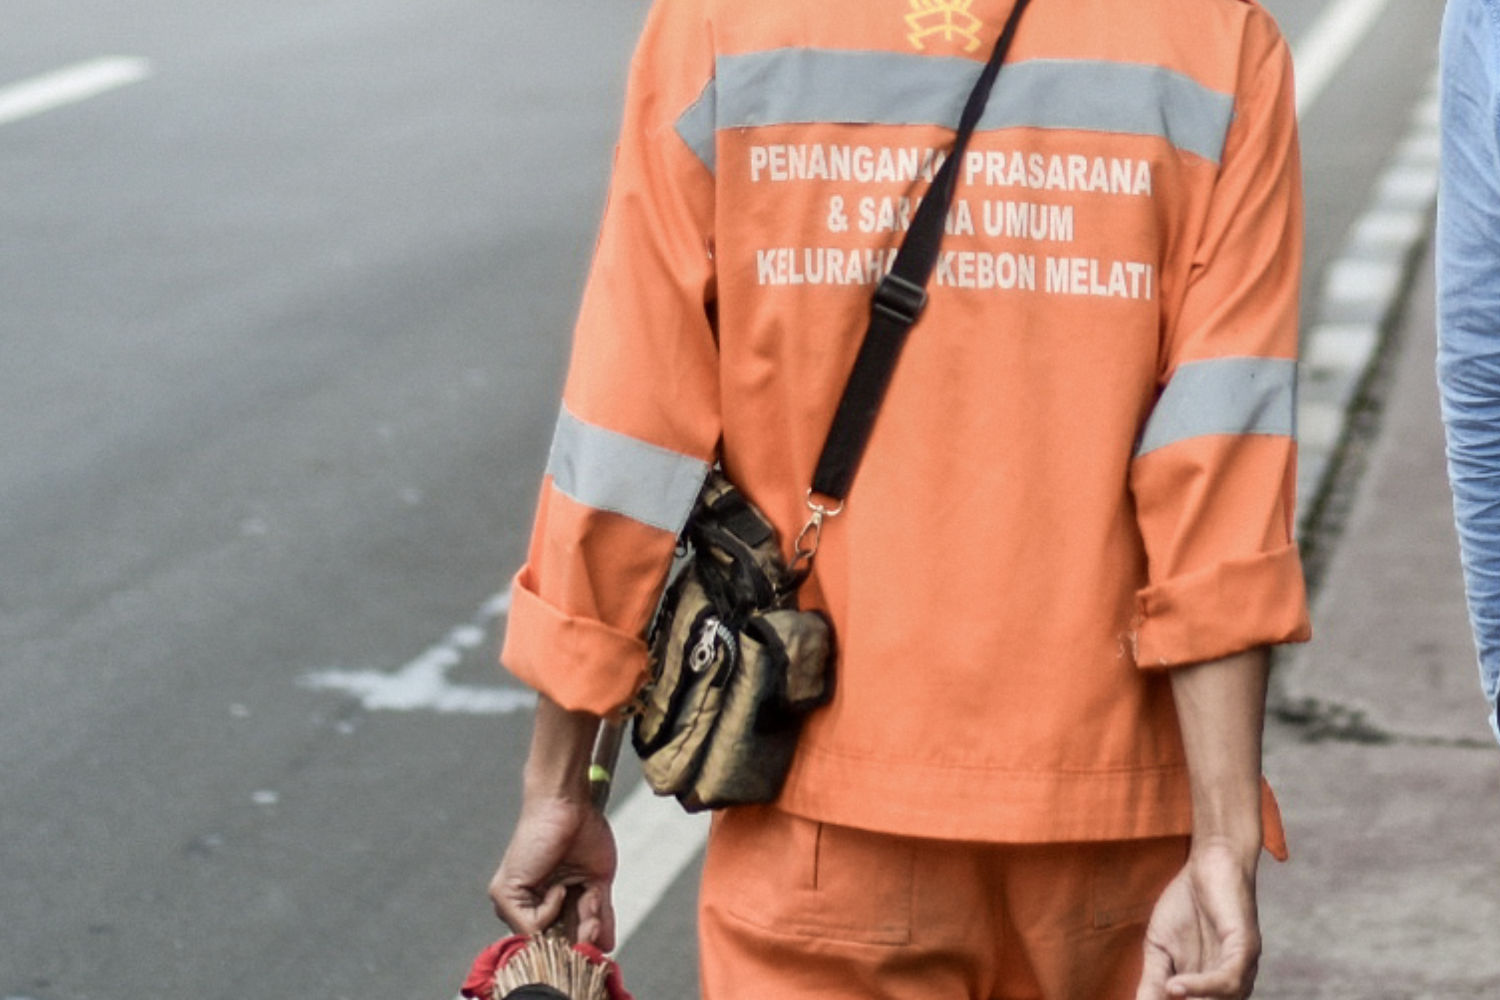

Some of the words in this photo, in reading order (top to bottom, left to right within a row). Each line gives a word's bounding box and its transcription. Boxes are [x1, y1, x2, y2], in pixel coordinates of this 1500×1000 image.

[965, 150, 1152, 197] PRASARANA
[827, 194, 849, 234] &
[858, 196, 975, 236] SARA
[983, 199, 1075, 242] UMUM
[756, 247, 899, 286] KELURAH
[936, 250, 1036, 291] KEBON
[1045, 256, 1153, 300] MELATI
